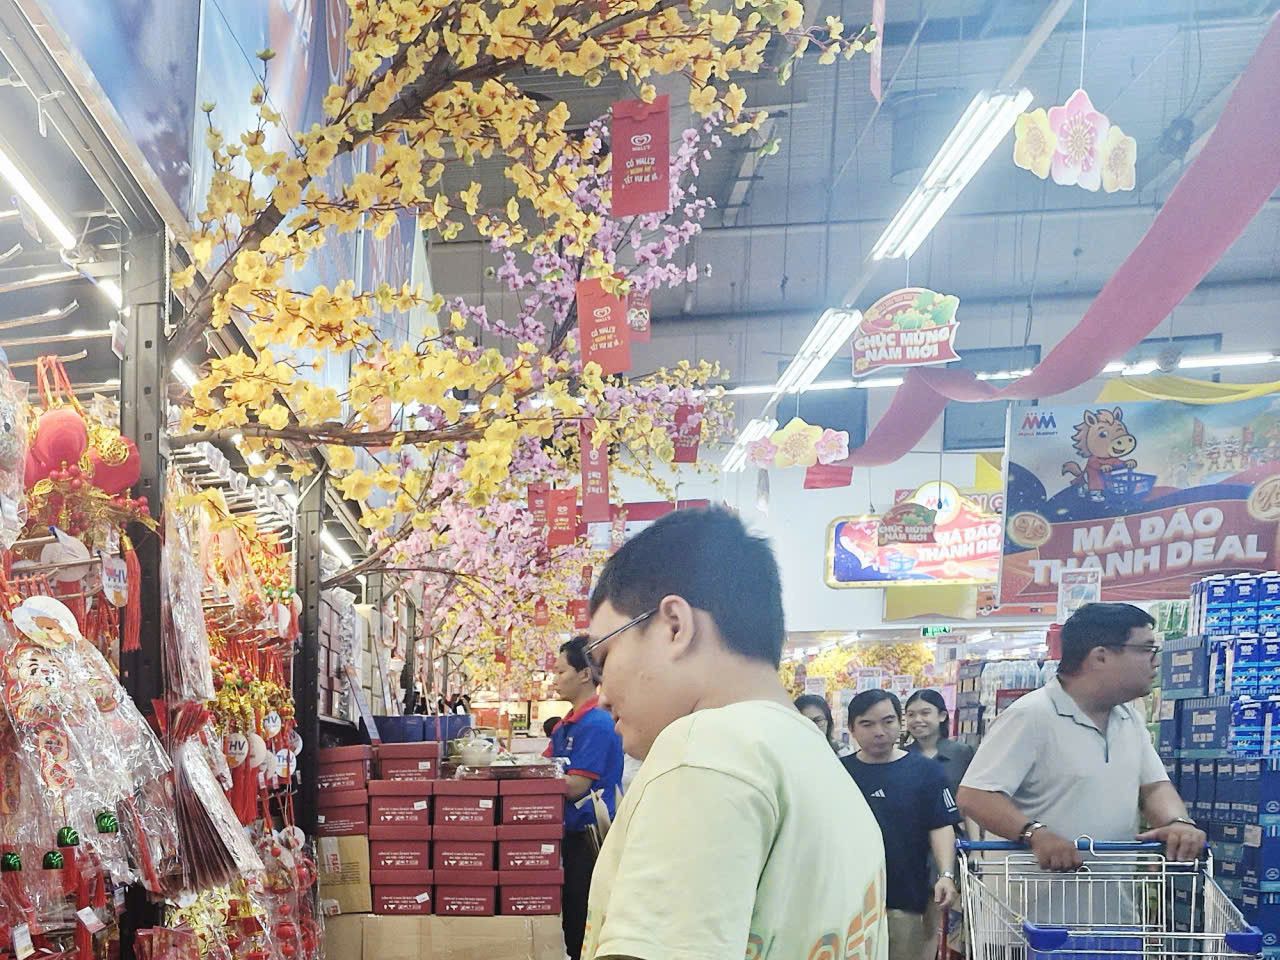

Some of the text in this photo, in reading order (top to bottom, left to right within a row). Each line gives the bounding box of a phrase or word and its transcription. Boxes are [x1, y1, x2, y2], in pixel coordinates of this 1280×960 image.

[854, 327, 950, 351] CHÚC MỪNG
[865, 343, 939, 361] NĂM MỚI
[1028, 533, 1268, 585] THÀNH DEAL
